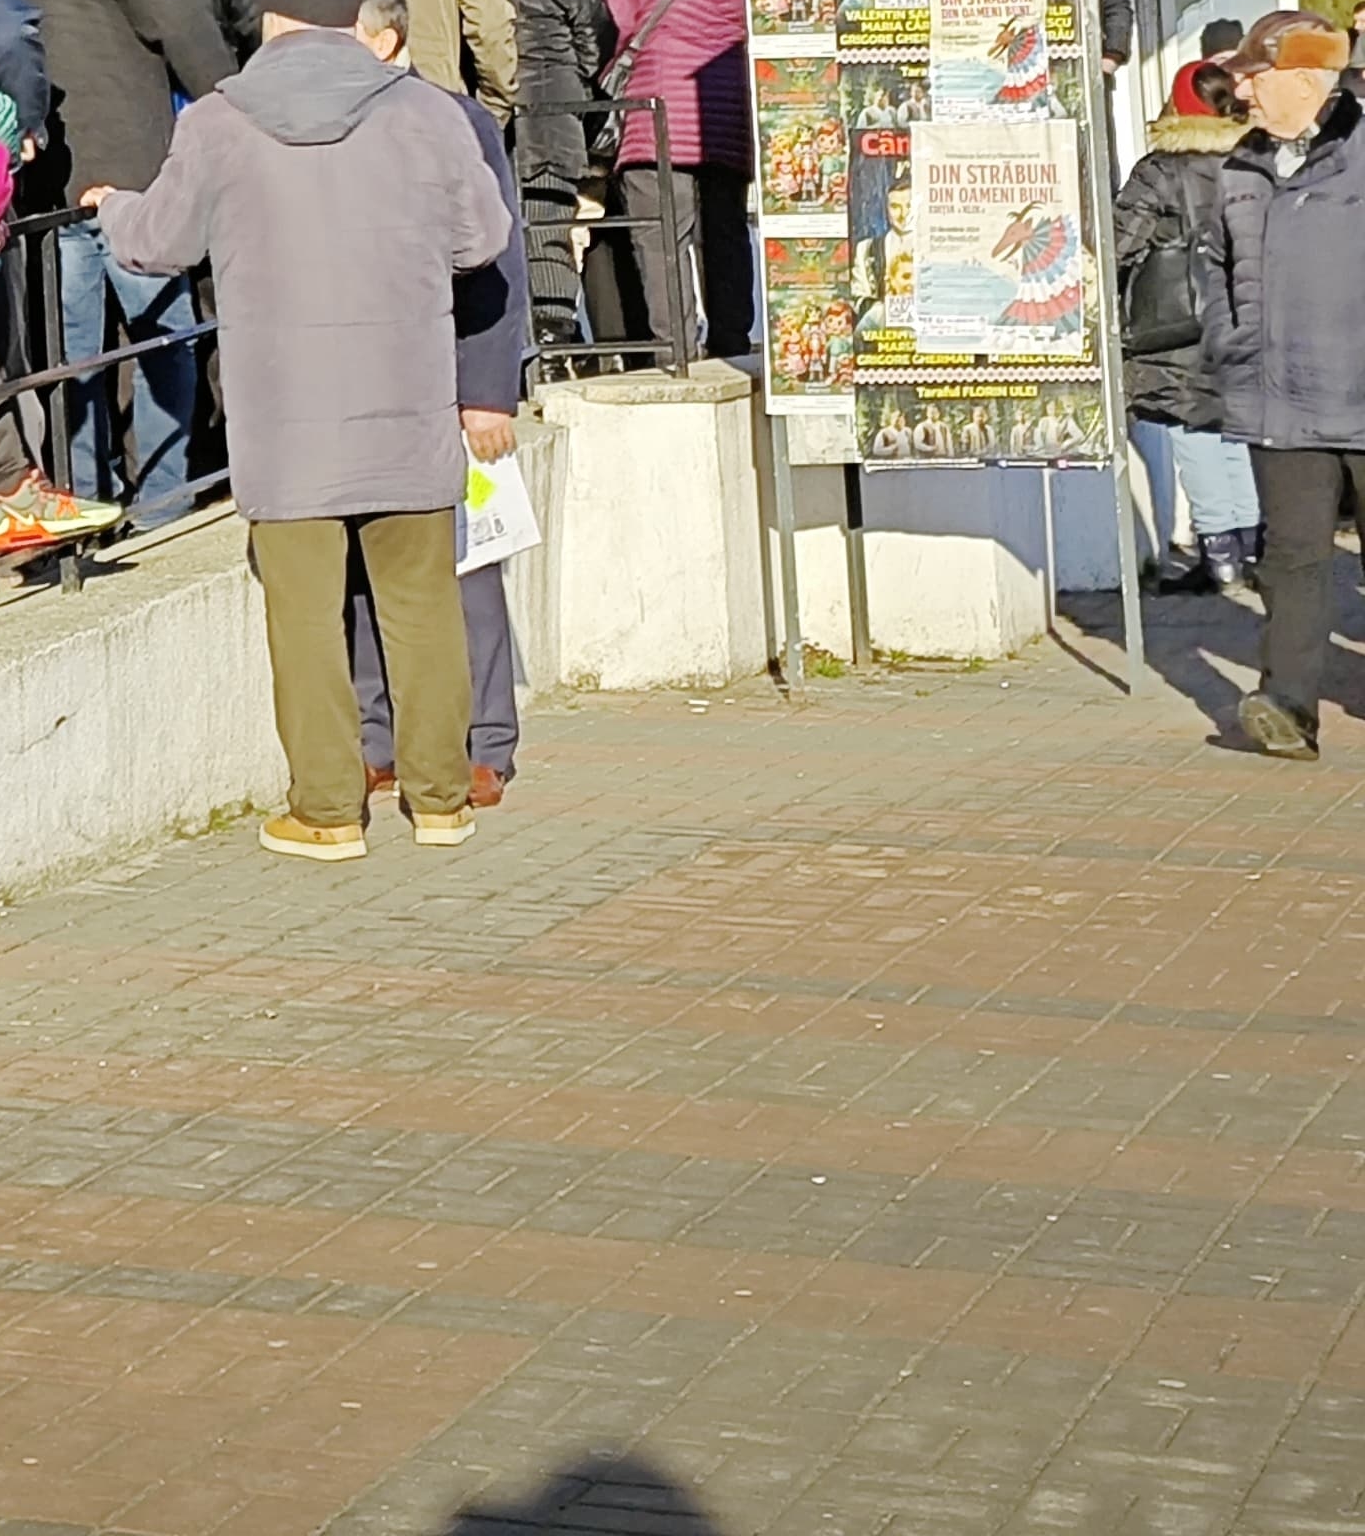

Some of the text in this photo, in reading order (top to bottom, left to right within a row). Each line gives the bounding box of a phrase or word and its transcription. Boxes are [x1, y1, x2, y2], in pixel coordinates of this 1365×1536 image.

[929, 163, 961, 185] DIN
[929, 187, 954, 203] DIN
[959, 187, 1015, 203] OAMENI
